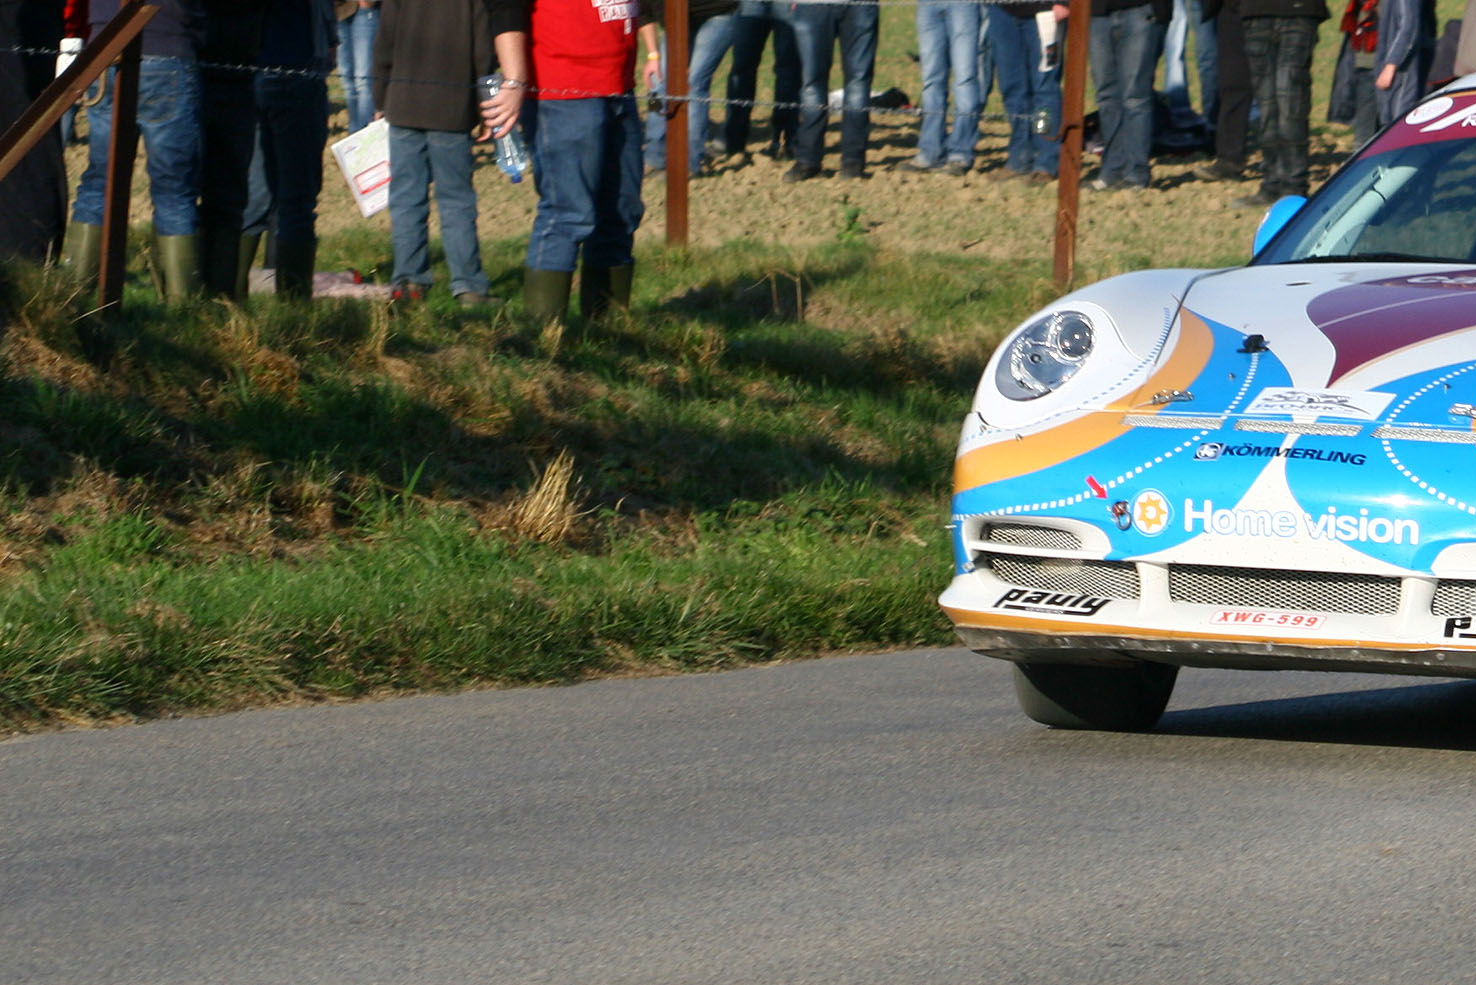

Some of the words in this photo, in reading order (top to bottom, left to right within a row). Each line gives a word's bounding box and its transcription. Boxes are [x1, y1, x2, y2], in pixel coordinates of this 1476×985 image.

[1222, 443, 1367, 466] KÖMMERLING
[1184, 498, 1297, 537] Home
[1303, 506, 1419, 545] vision
[993, 587, 1112, 616] pauly
[1217, 610, 1319, 628] XWG-599
